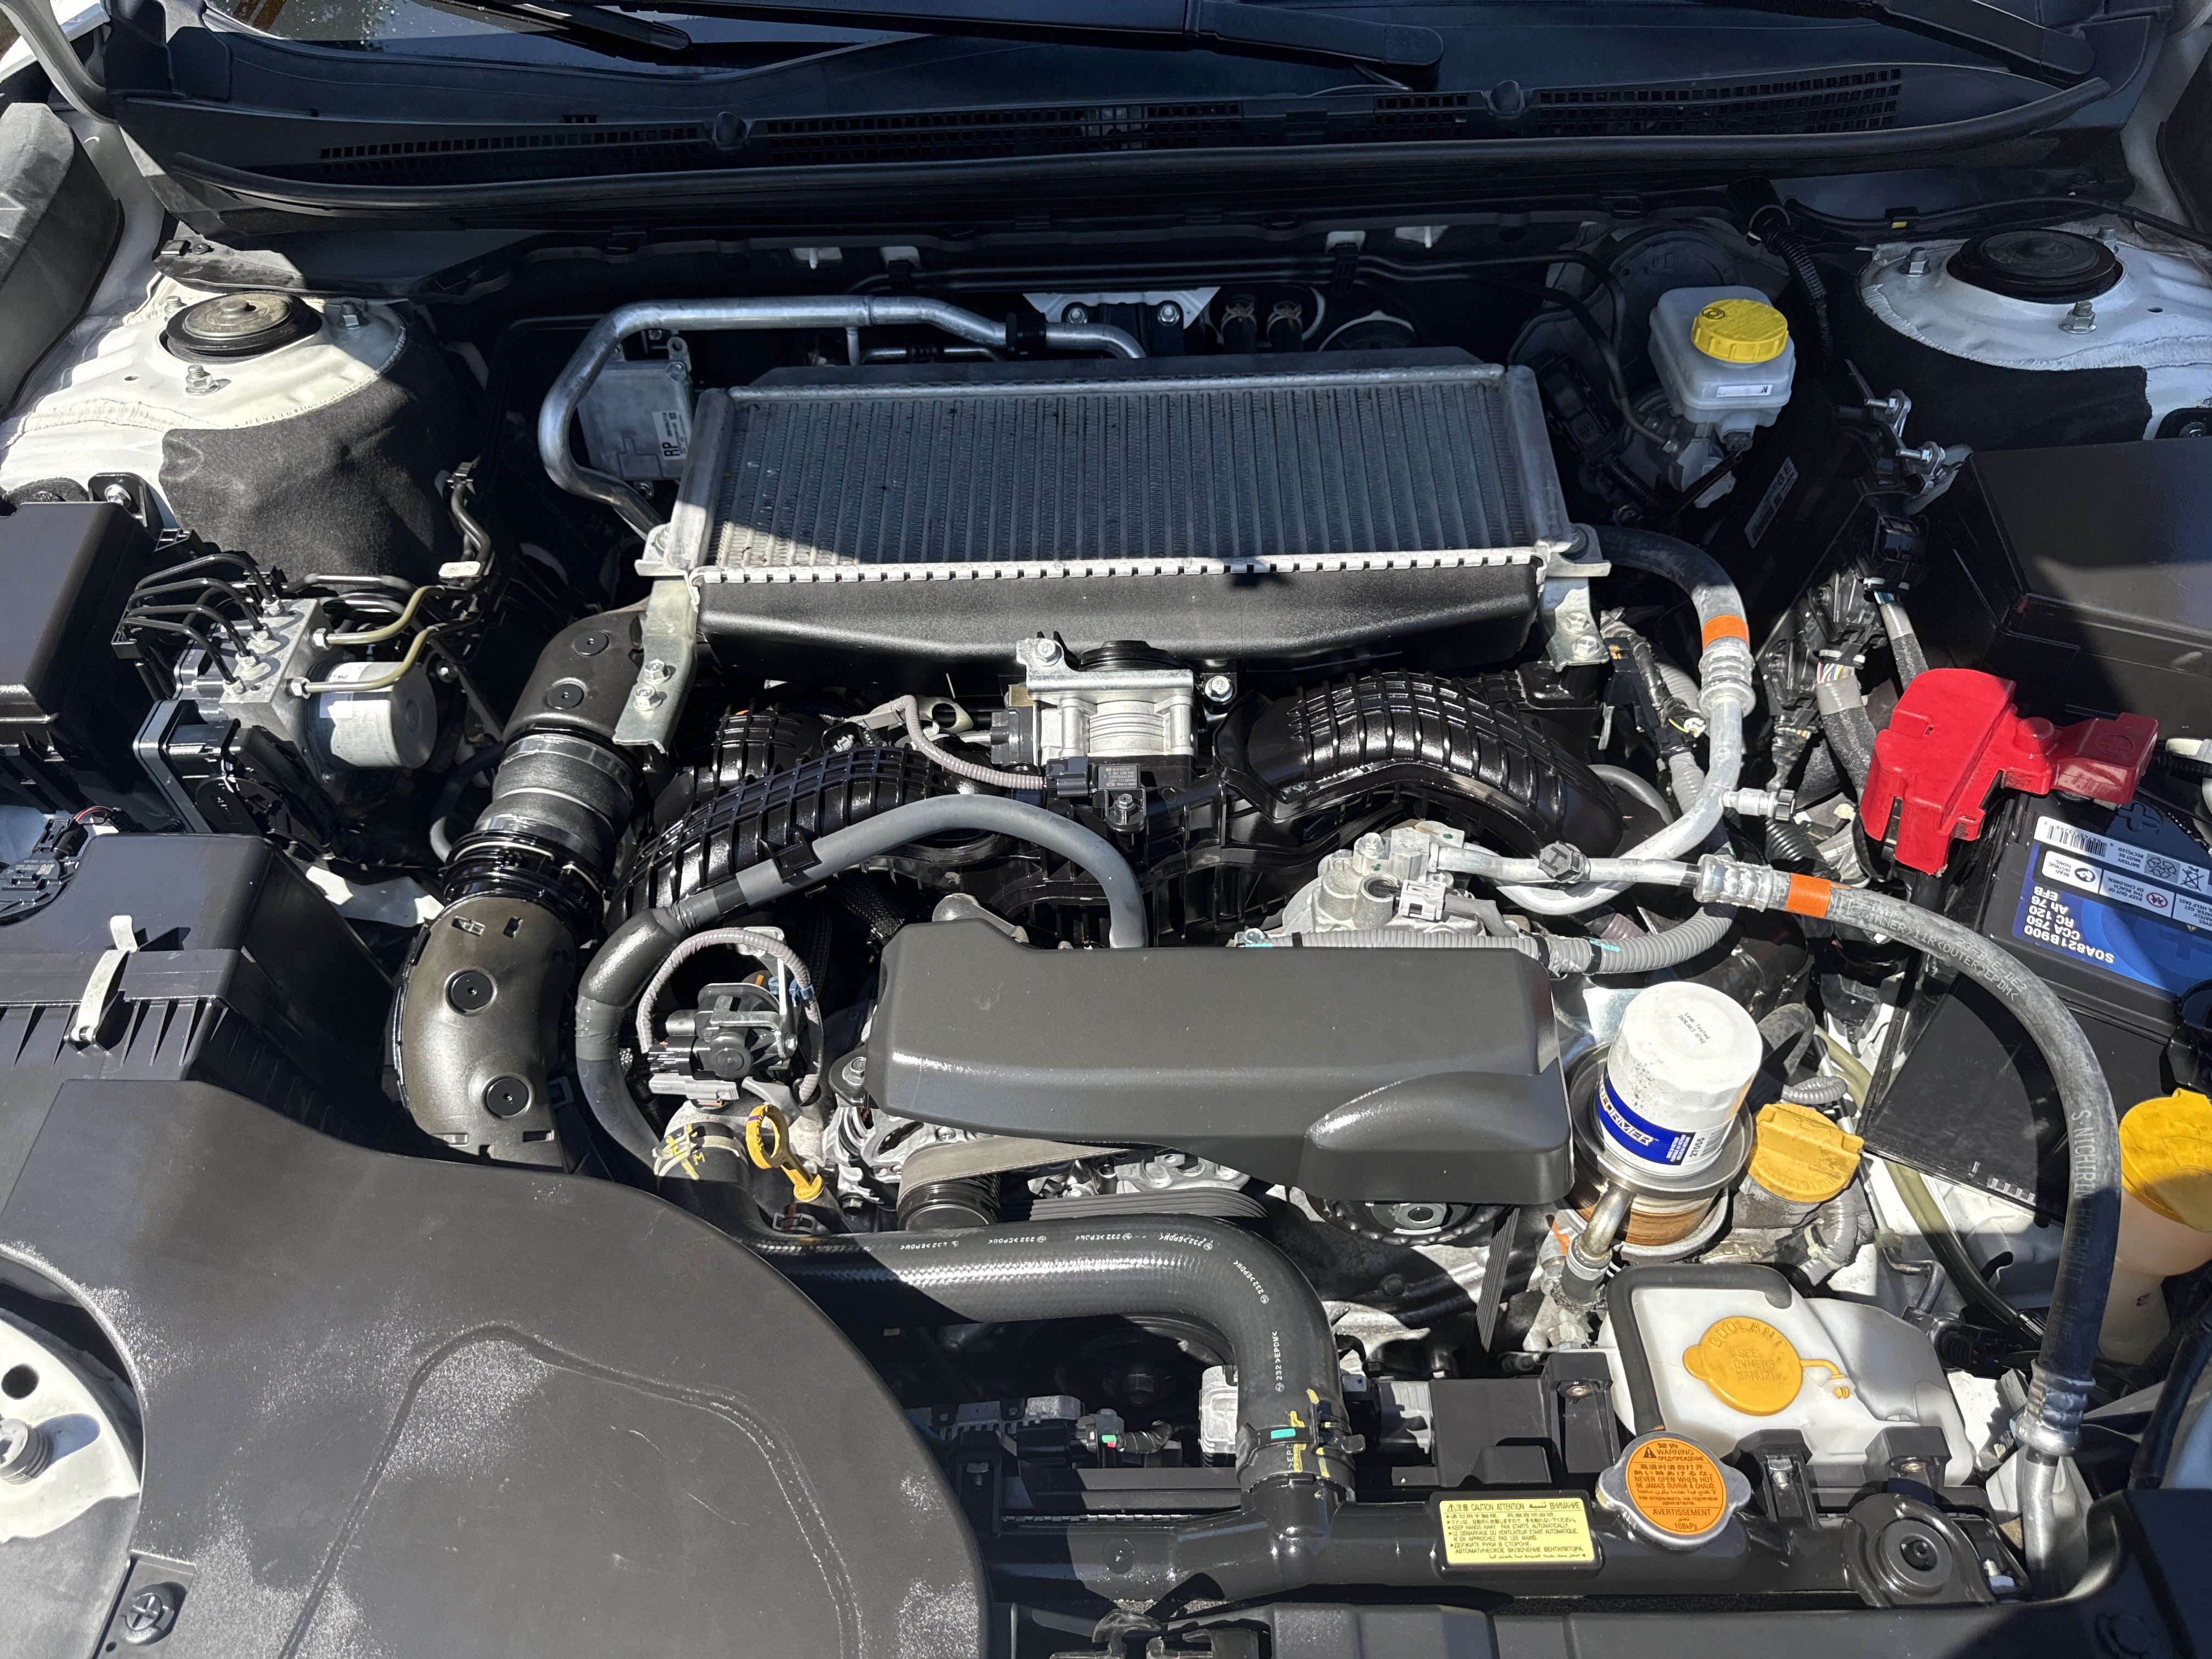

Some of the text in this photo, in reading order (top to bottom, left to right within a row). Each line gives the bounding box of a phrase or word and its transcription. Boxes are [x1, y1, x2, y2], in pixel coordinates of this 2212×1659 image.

[2118, 847, 2144, 859] RECYCLED
[2118, 857, 2140, 868] BATTERY
[2034, 886, 2058, 901] EFB
[2114, 884, 2132, 894] REACH
[2031, 895, 2069, 915] Ah 76
[2029, 905, 2074, 928] RC 120
[2027, 915, 2080, 940] CCA 750
[1689, 1137, 1705, 1157] 27055
[1253, 1280, 1264, 1294] 232
[1708, 1319, 1787, 1348] COOLANT
